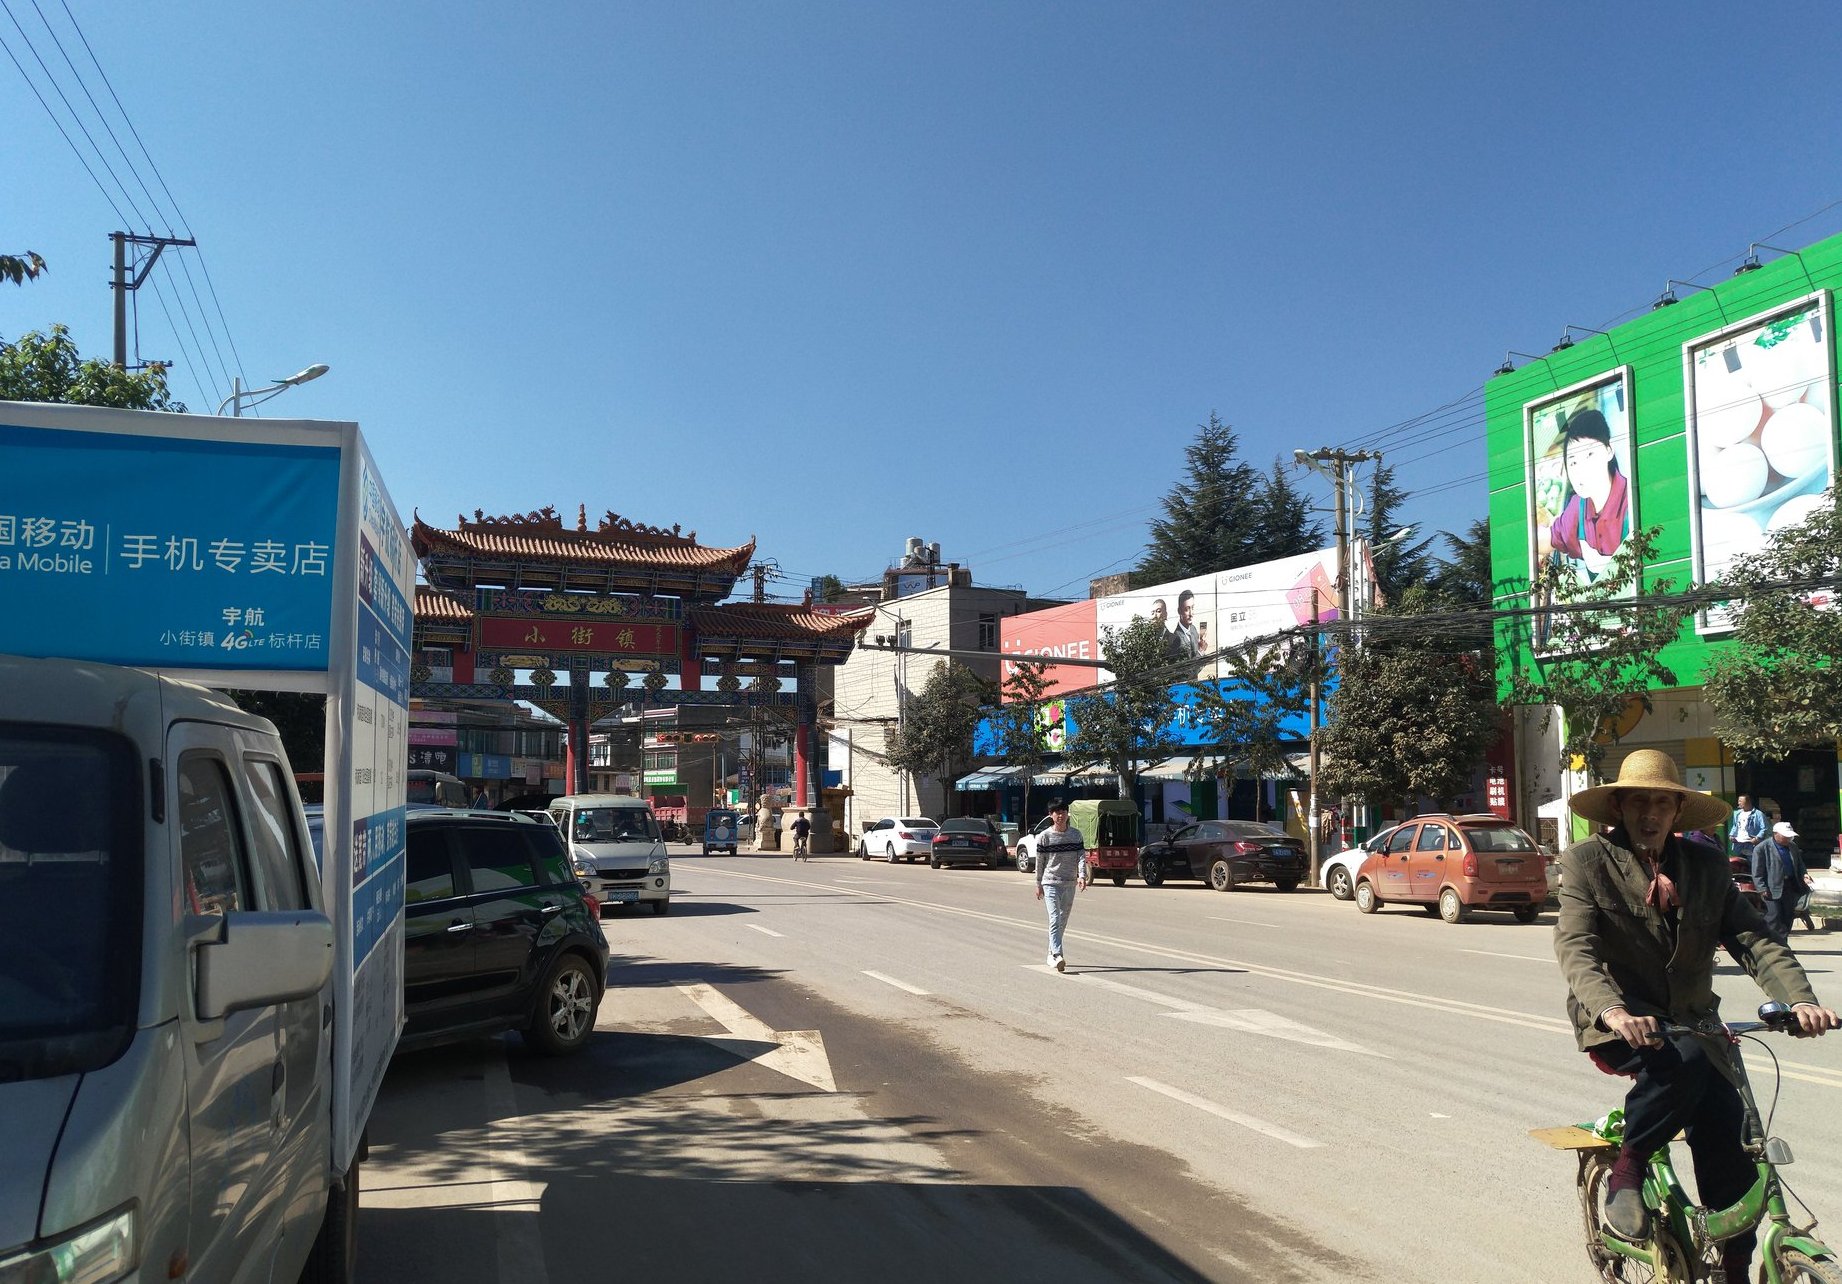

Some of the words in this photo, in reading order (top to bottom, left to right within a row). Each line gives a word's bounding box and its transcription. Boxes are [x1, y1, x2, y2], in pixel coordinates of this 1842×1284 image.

[17, 552, 93, 574] Mobile
[120, 534, 329, 576] 手机专卖店
[222, 607, 265, 626] 宇航
[160, 630, 215, 647] 小街镇
[268, 632, 321, 649] 标杆店
[525, 625, 637, 650] 小街镇
